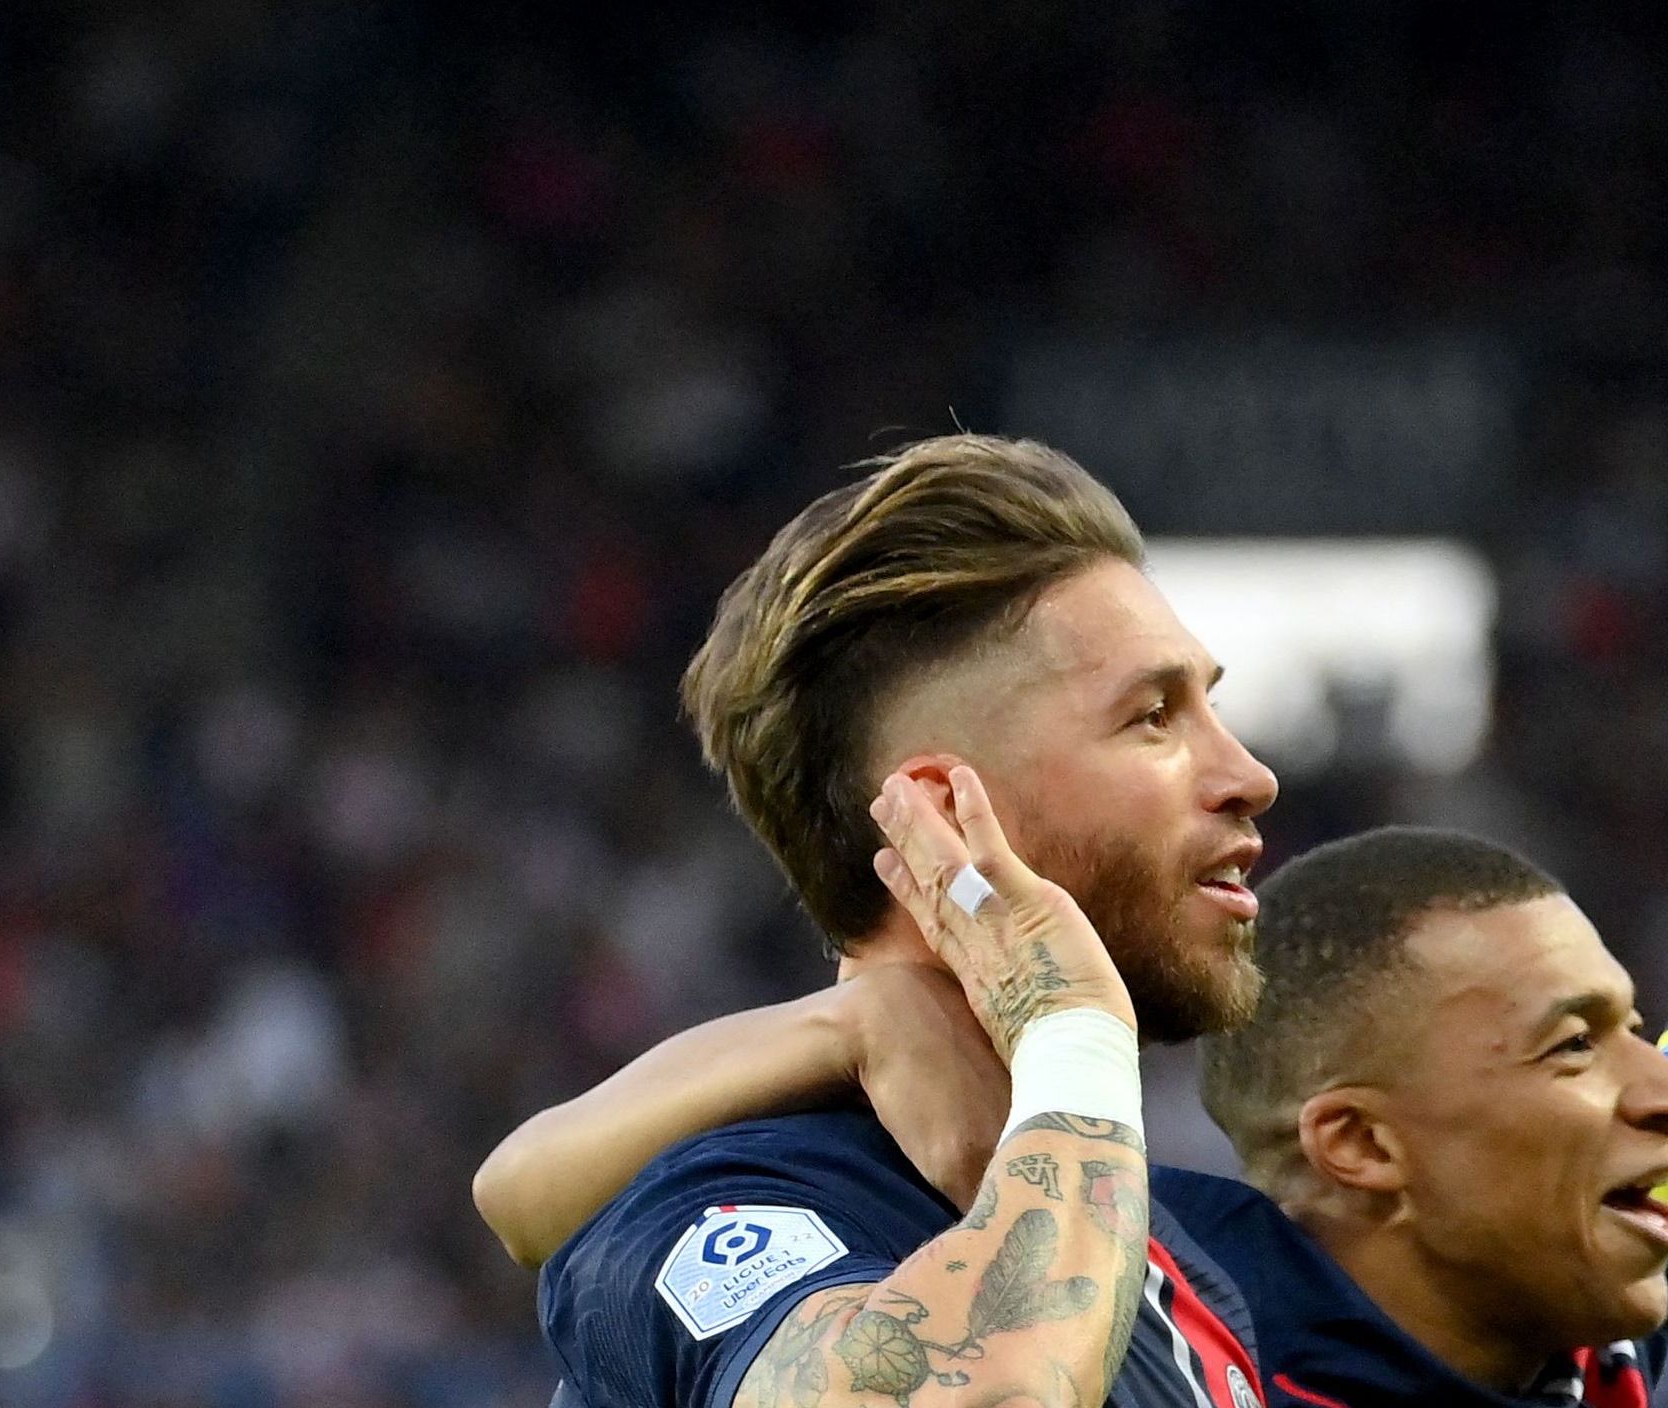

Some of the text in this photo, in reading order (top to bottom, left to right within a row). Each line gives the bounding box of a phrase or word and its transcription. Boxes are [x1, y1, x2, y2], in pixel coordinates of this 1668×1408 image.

[723, 1253, 779, 1292] LIGUE
[723, 1277, 761, 1309] Uber
[763, 1256, 807, 1279] Eats
